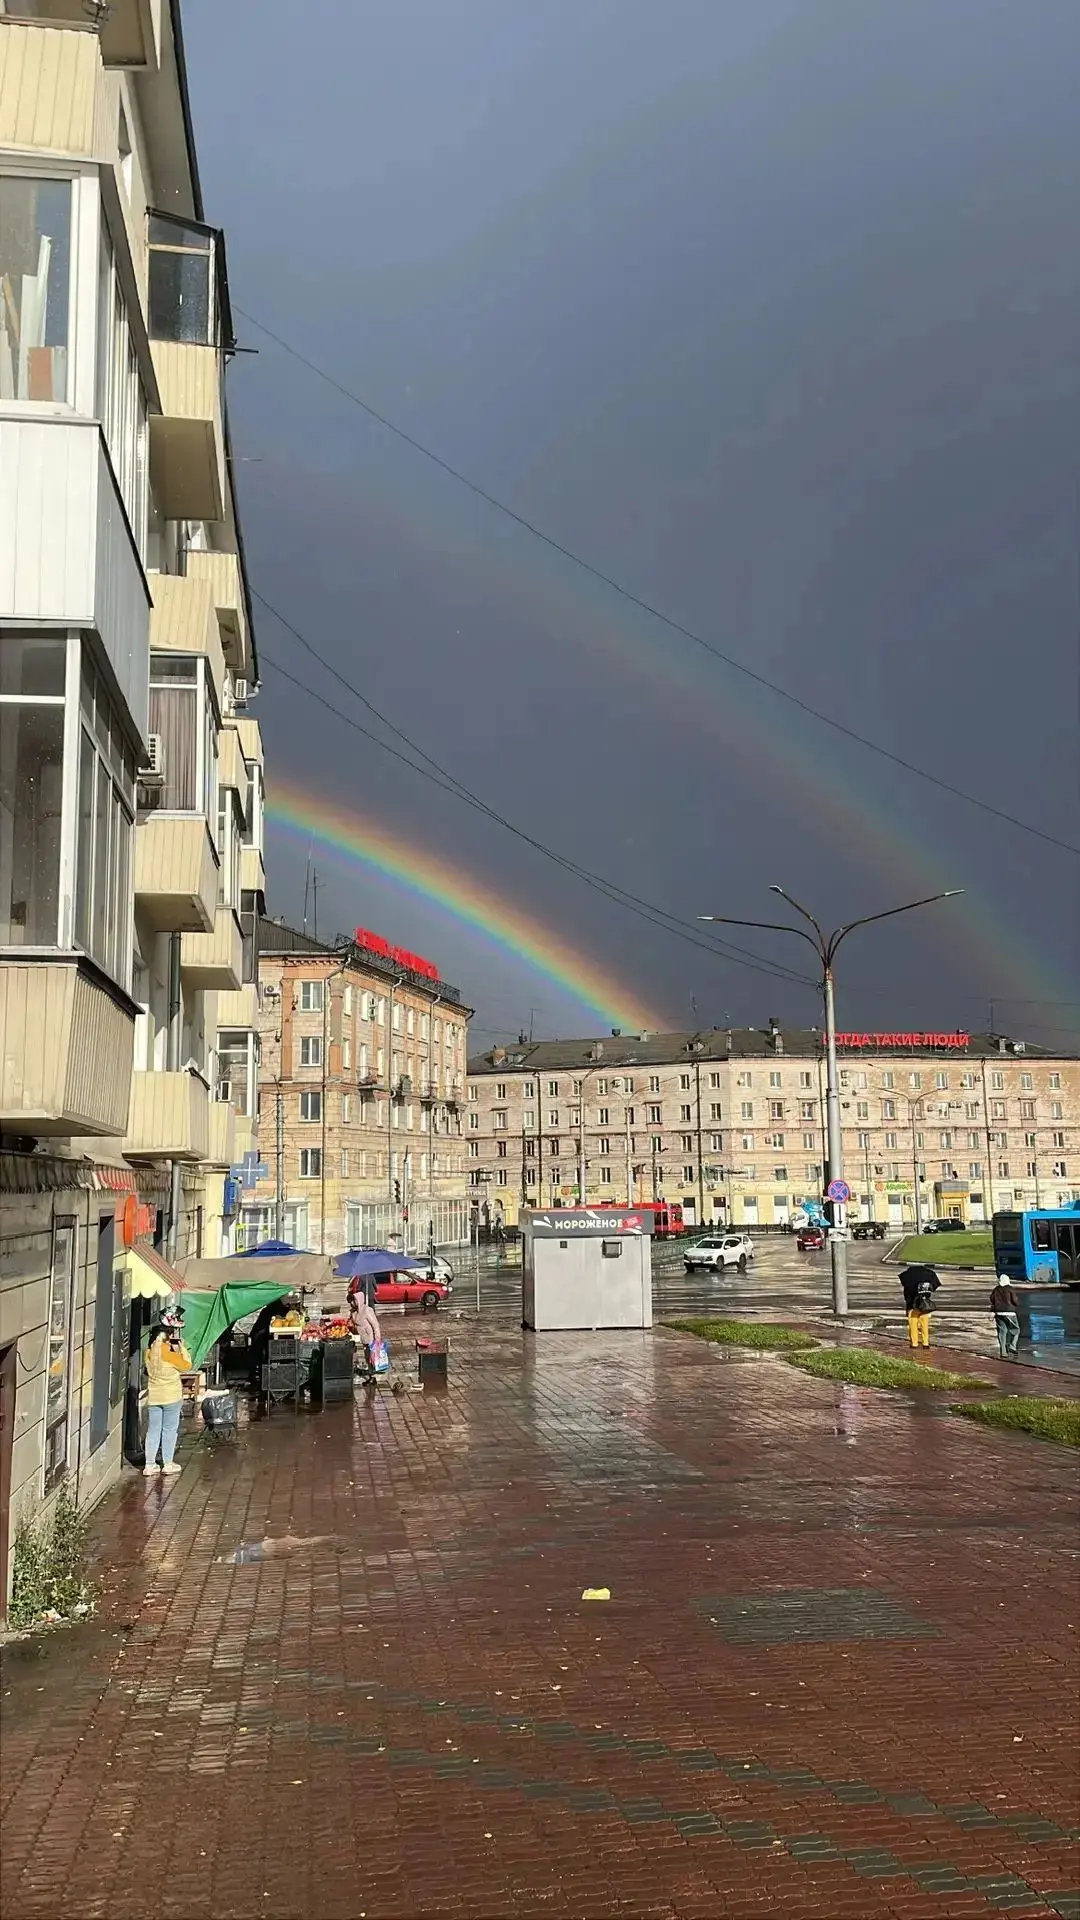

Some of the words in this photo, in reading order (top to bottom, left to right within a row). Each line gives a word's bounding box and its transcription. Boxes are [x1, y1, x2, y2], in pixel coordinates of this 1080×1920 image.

[873, 1033, 920, 1046] ТАКИЕ
[923, 1033, 969, 1047] ЛЮДИ
[555, 1219, 623, 1230] МОРОЖЕНОЕ
